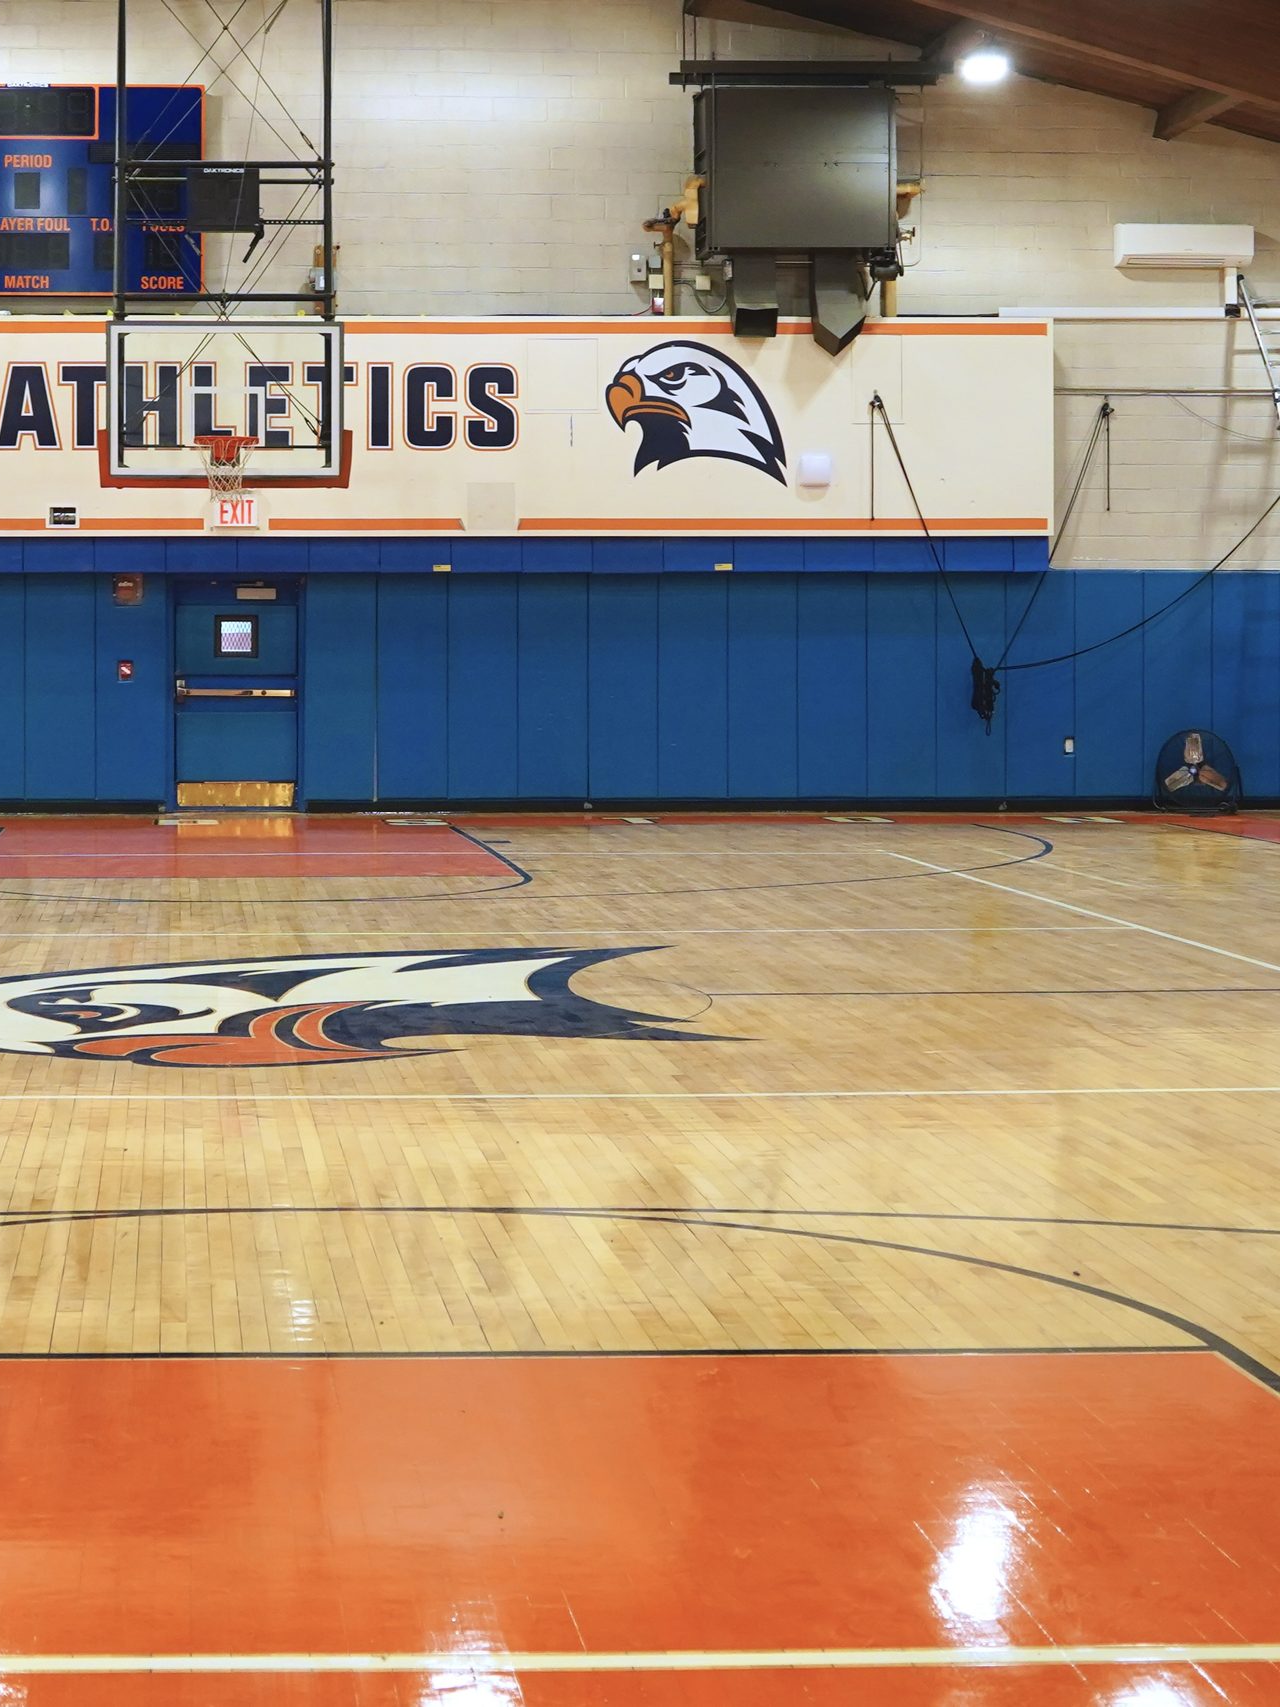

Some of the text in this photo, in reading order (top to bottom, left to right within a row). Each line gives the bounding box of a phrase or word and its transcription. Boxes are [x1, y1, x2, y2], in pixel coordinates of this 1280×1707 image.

[4, 154, 52, 168] PERIOD
[37, 218, 71, 231] FOUL
[90, 218, 114, 231] T.O.
[4, 275, 49, 288] MATCH
[140, 275, 184, 289] SCORE
[220, 499, 254, 524] EXIT
